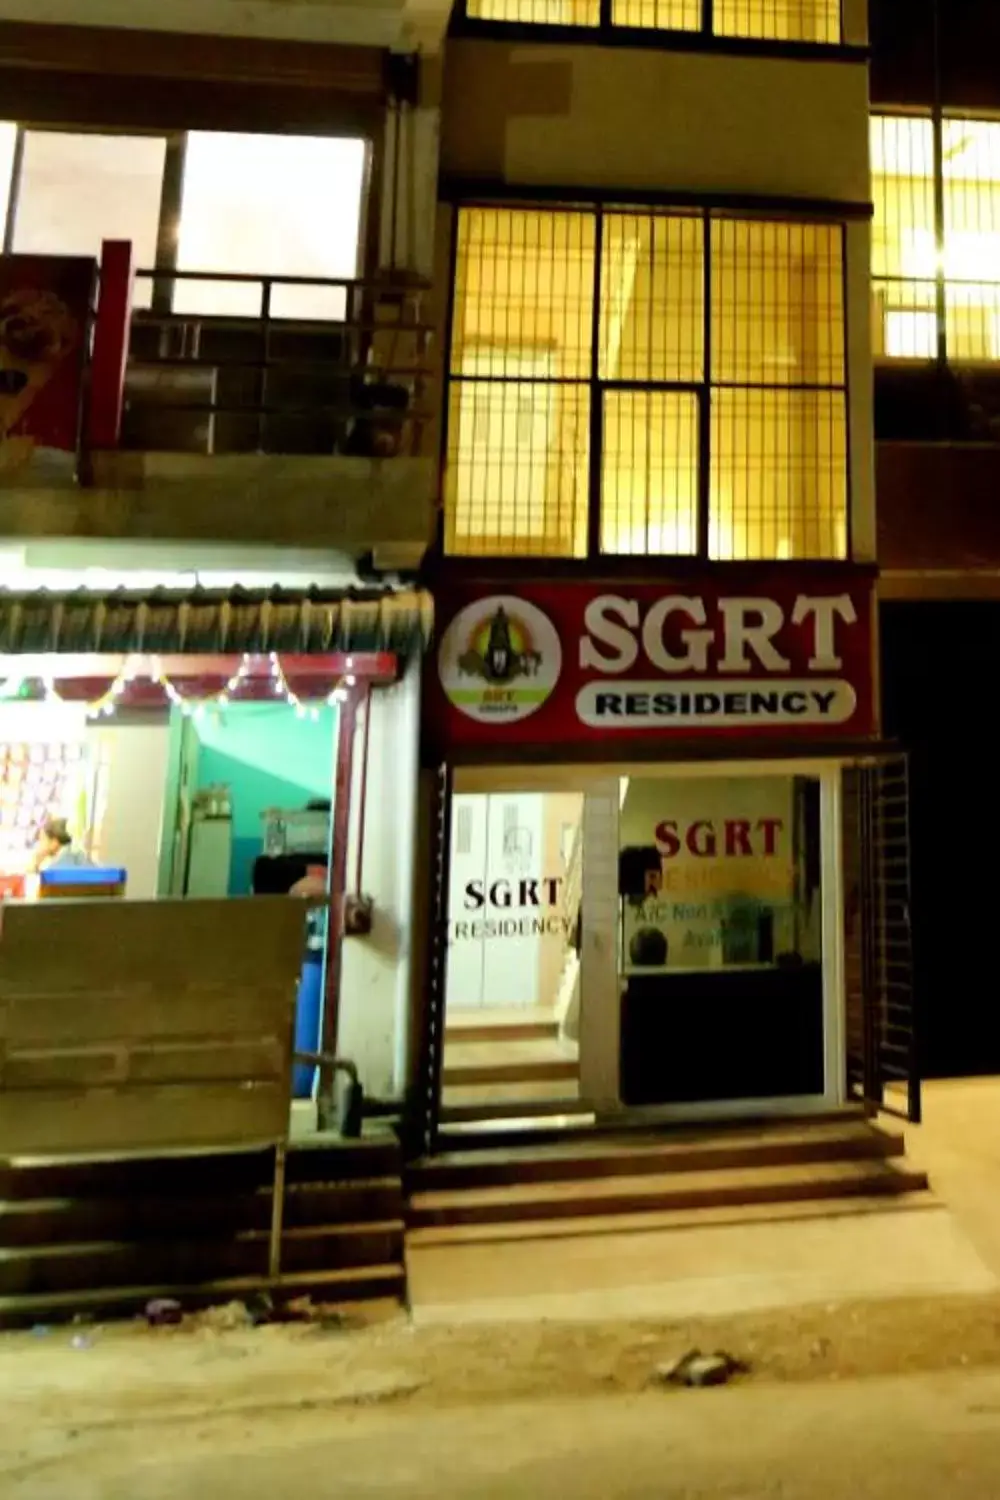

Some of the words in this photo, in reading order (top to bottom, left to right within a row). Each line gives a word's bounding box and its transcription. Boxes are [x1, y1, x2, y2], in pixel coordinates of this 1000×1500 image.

[579, 594, 858, 674] SGRT
[595, 690, 838, 716] RESIDENCY
[655, 819, 784, 857] SGRT
[464, 877, 563, 910] SGRT
[455, 915, 571, 939] RESIDENCY
